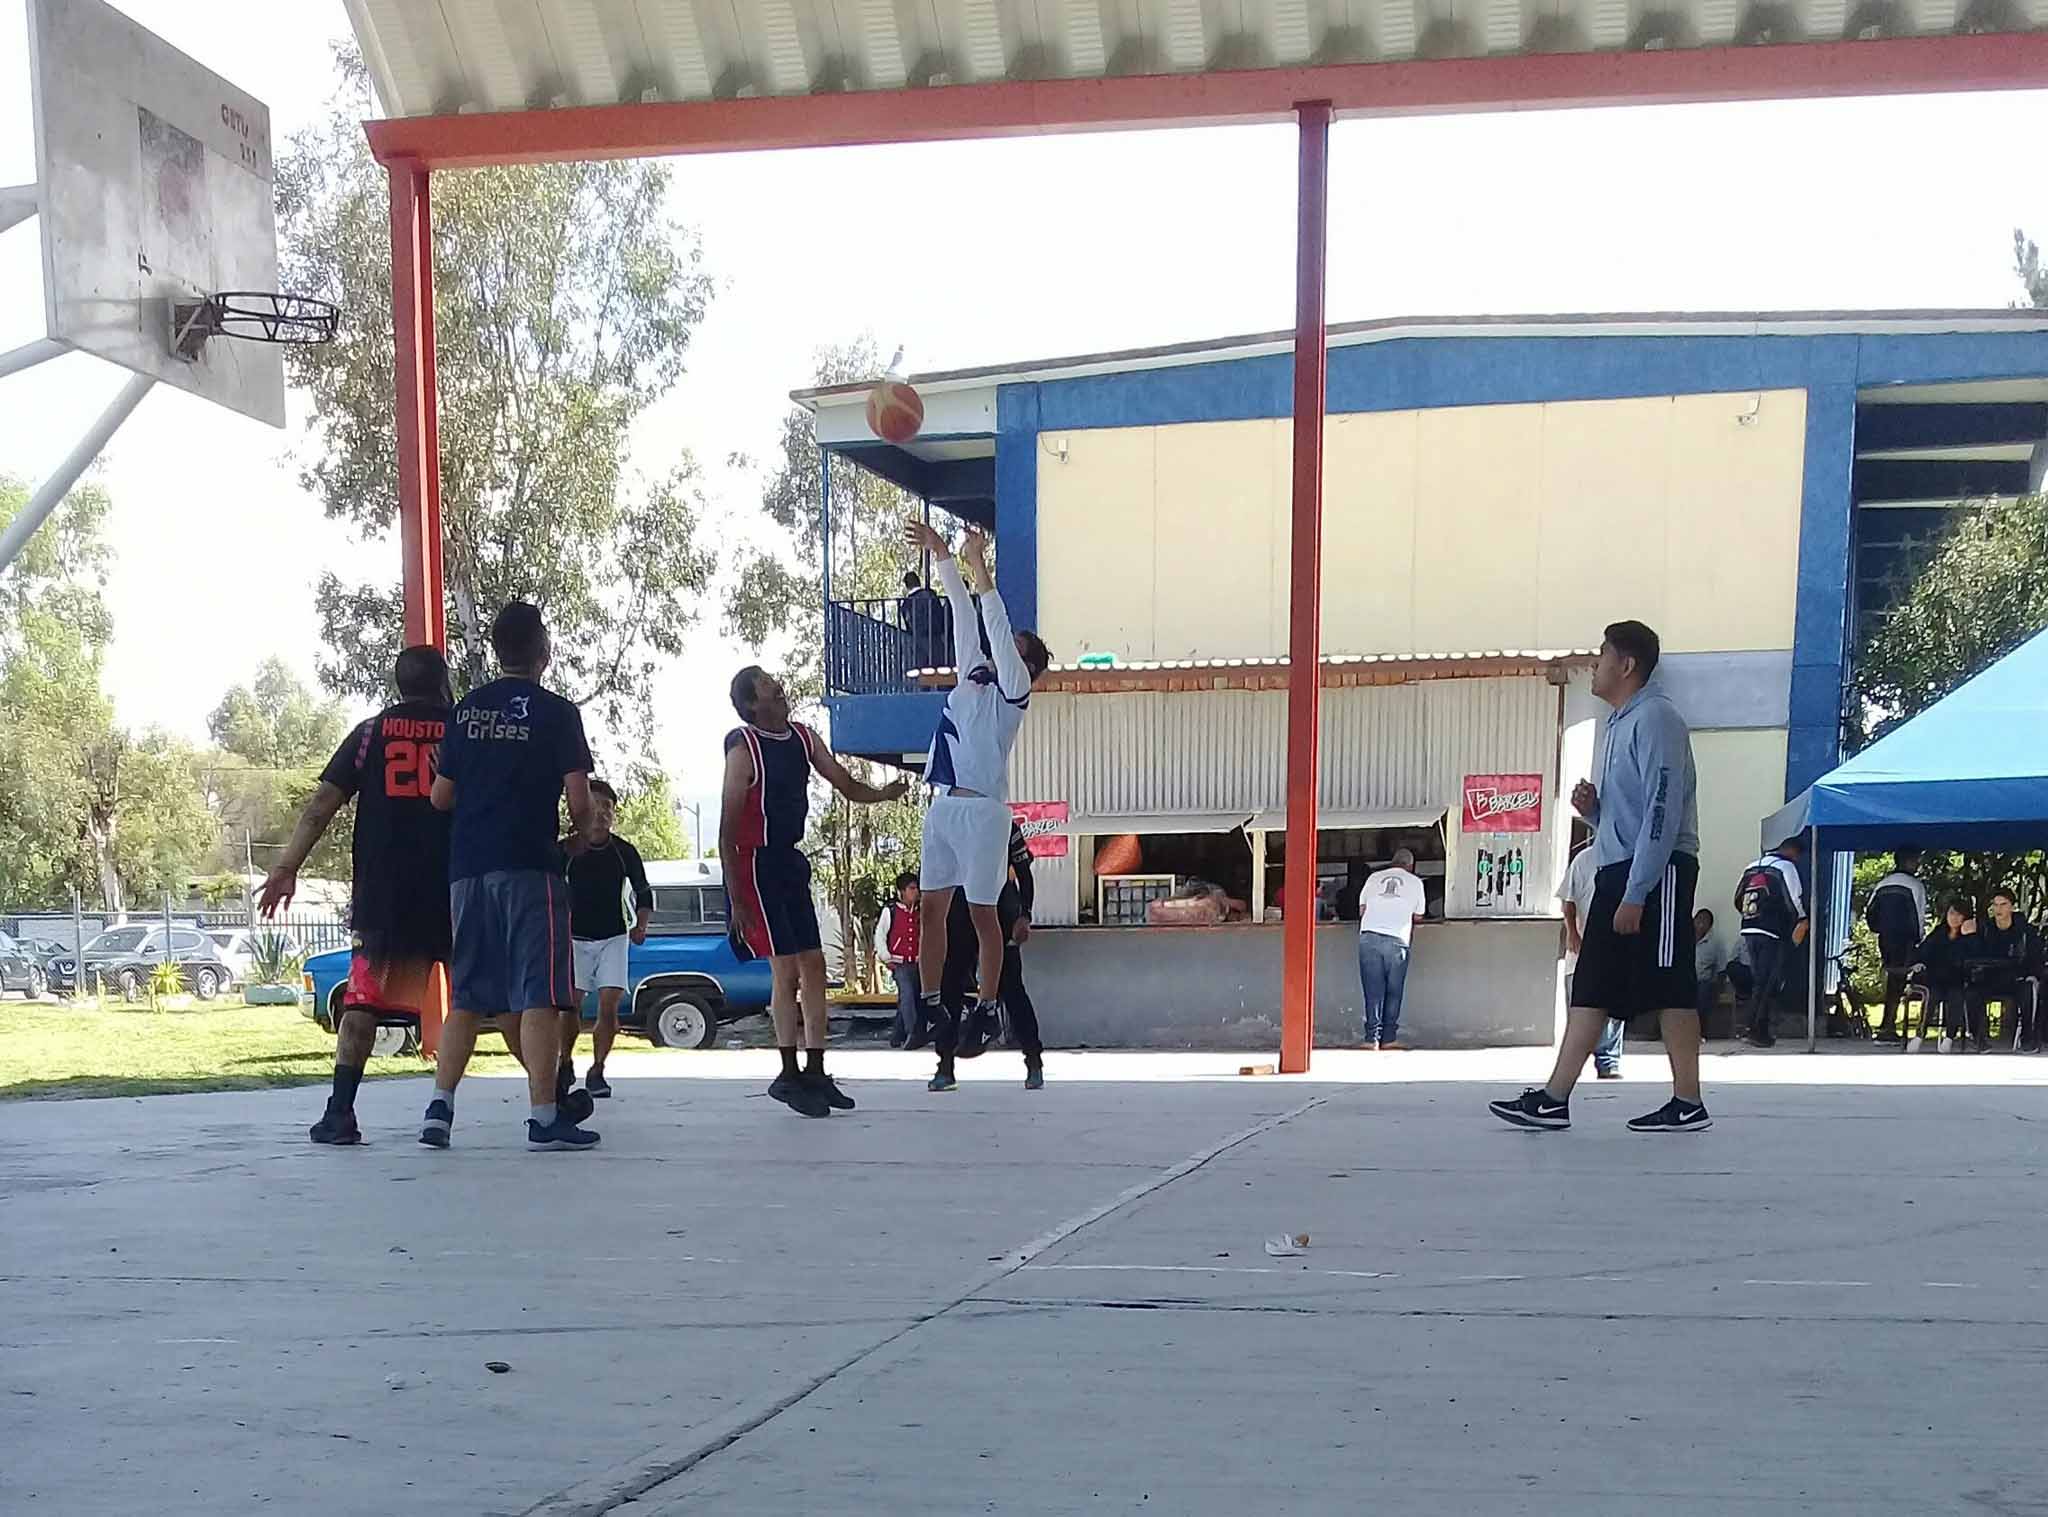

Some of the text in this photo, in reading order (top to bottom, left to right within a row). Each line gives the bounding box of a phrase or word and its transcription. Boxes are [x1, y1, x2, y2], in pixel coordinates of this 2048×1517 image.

[456, 706, 500, 724] Lobos
[382, 717, 446, 739] HOUSTO
[467, 718, 530, 741] Grises
